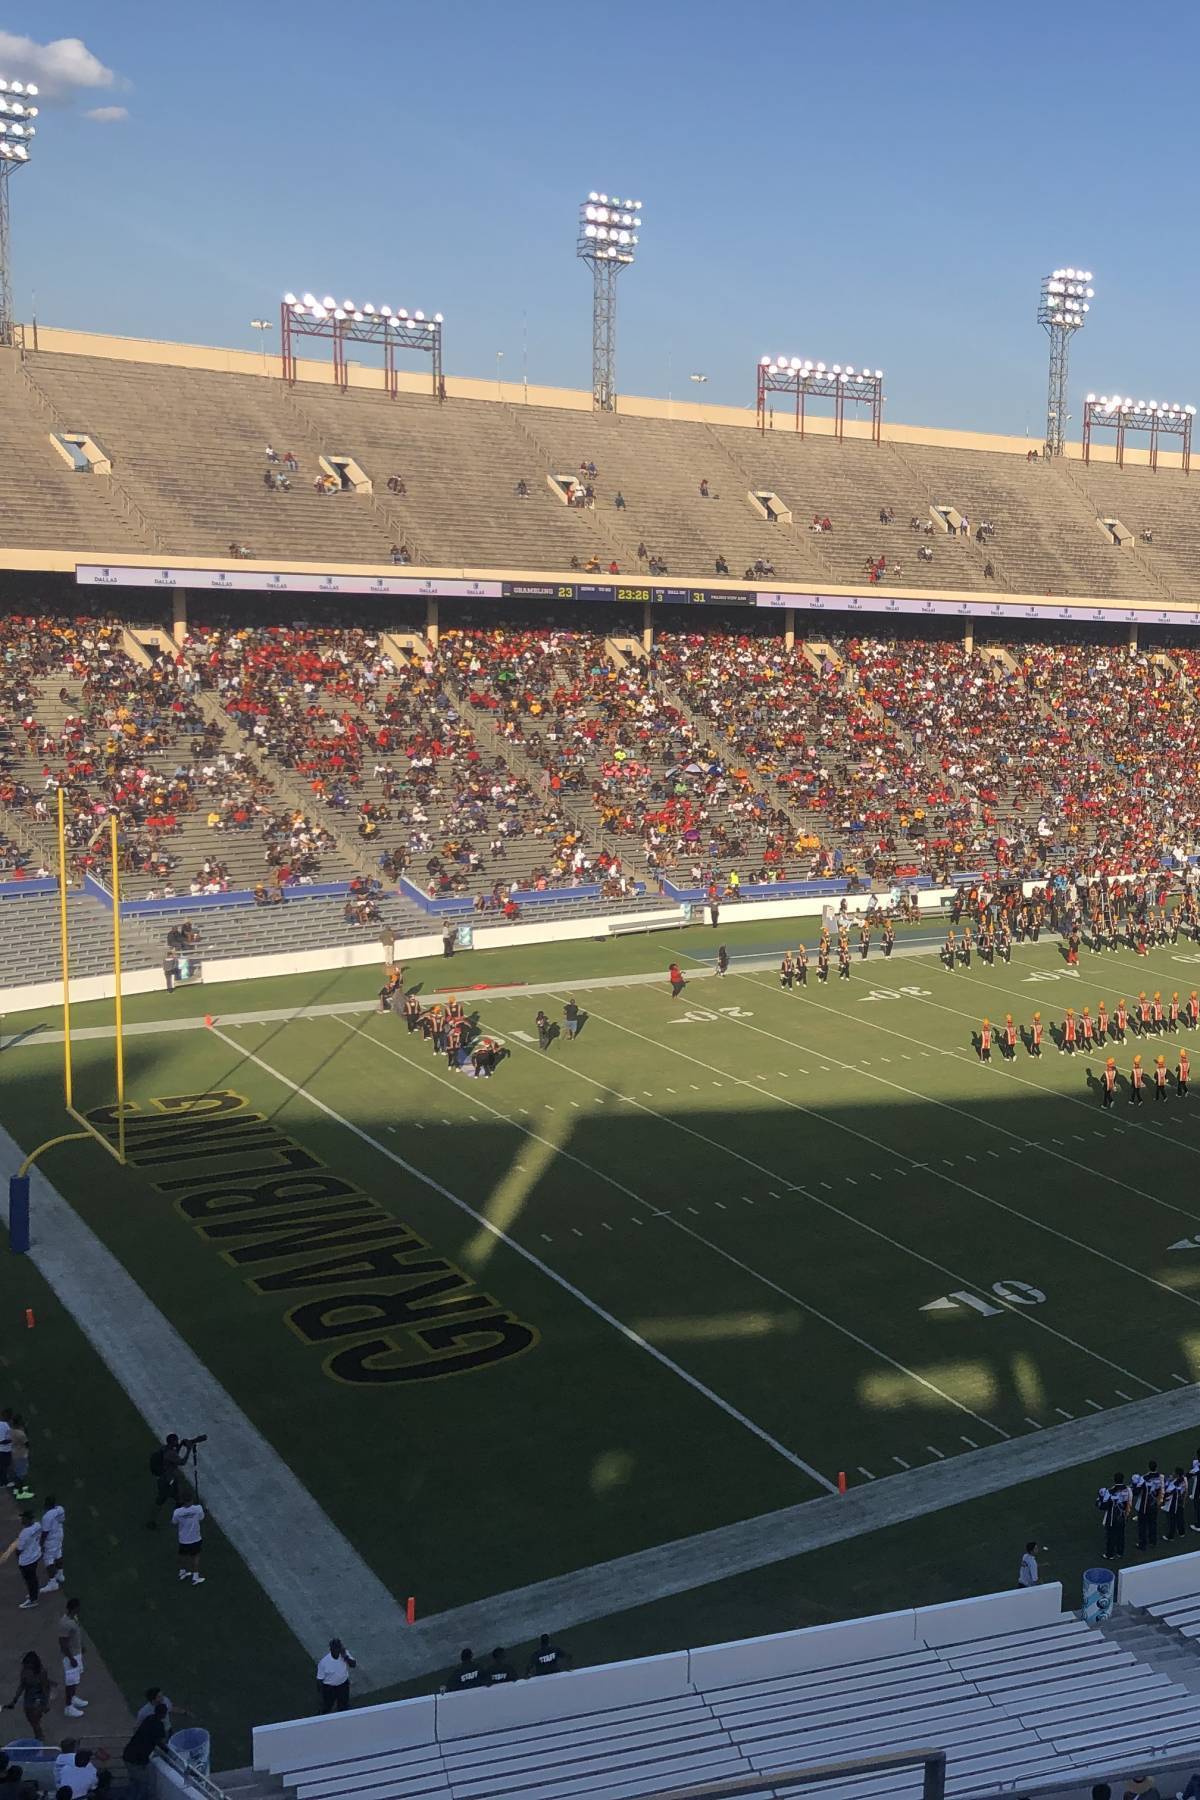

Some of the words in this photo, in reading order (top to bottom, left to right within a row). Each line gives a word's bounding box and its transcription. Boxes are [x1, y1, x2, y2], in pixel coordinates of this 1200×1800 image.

[558, 587, 573, 598] 23
[618, 590, 649, 601] 23:26
[693, 592, 706, 603] 31
[868, 986, 933, 1000] 30
[684, 1006, 754, 1022] 20
[84, 1088, 541, 1387] GRAMBLING
[949, 1280, 1047, 1317] 10
[460, 1670, 479, 1682] STAFF
